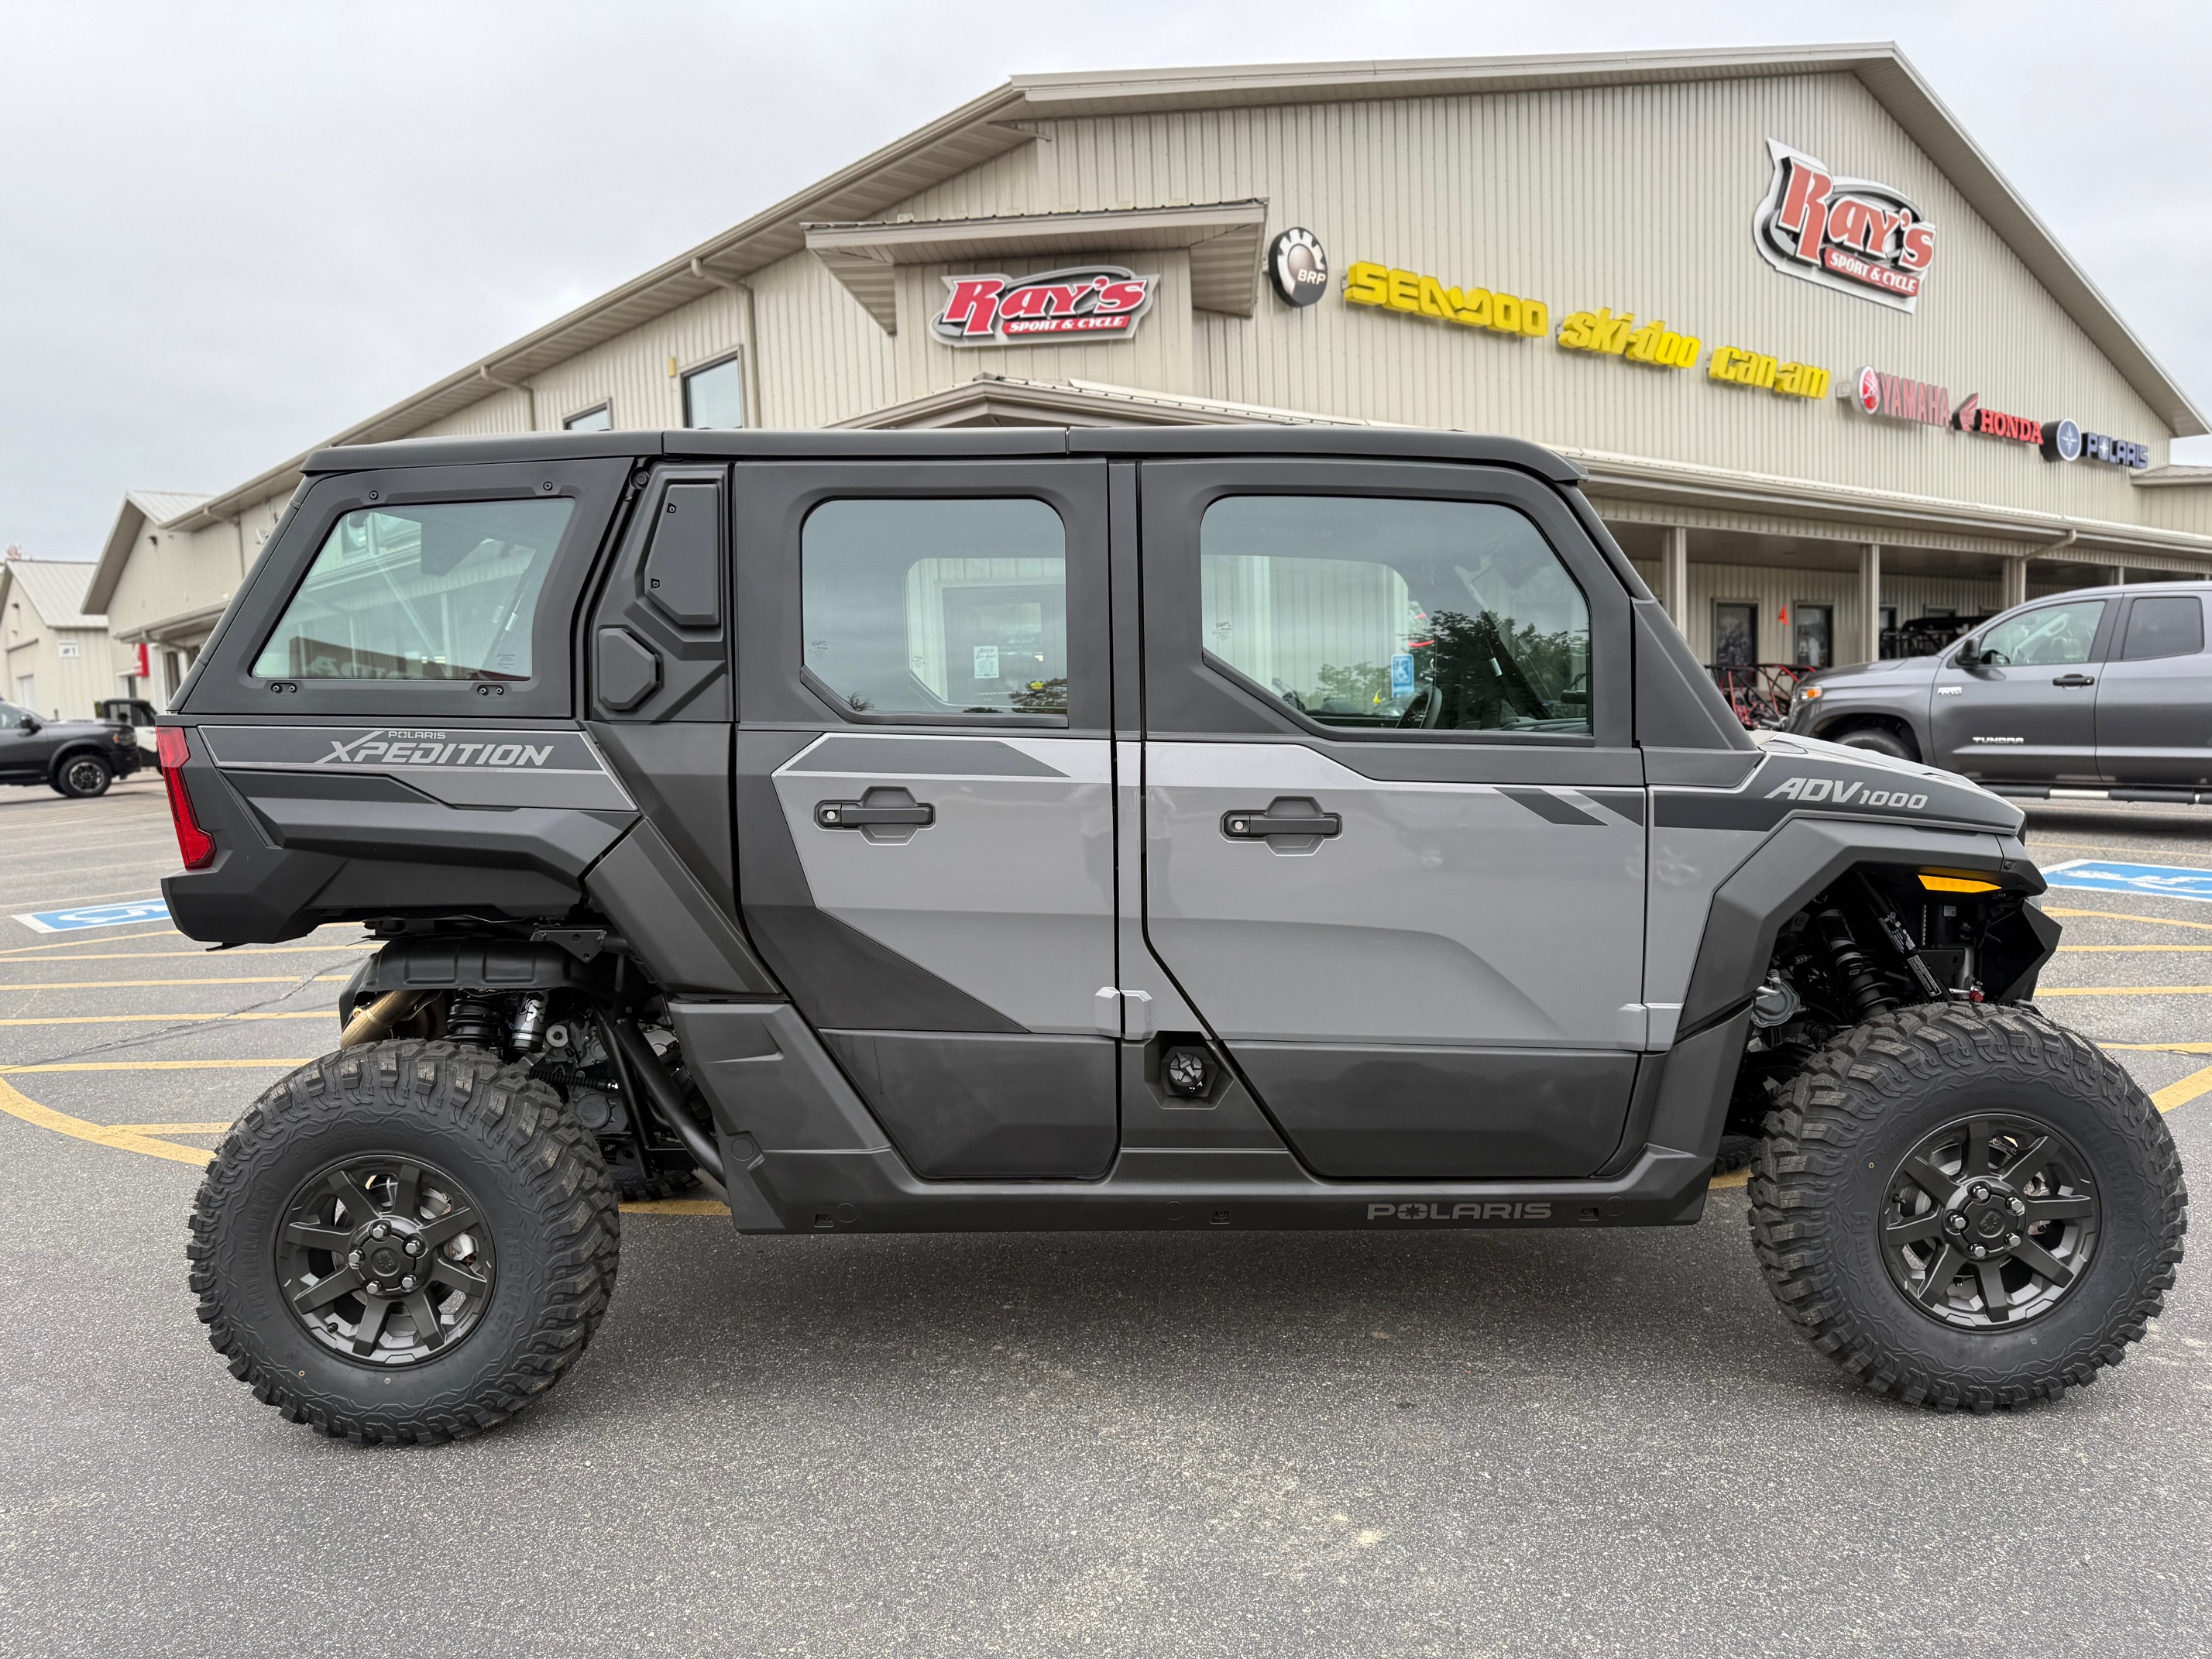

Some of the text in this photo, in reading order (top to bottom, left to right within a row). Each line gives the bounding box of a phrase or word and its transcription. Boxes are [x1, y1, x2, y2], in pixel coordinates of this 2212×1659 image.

[1297, 268, 1326, 285] BRP
[1829, 251, 1916, 293] SPORT & CYCLE
[1009, 316, 1125, 332] SPORT & CYCLE
[1879, 372, 1950, 428] YAMAHA
[1980, 407, 2045, 445] HONDA
[2083, 432, 2148, 469] POLARIS
[313, 730, 555, 766] XPEDITION
[387, 731, 446, 740] POLARIS
[1763, 777, 1929, 809] ADV 1000
[1366, 1203, 1552, 1221] POLARIS
[242, 1204, 269, 1277] ARMOR
[491, 1221, 524, 1340] TREKKER
